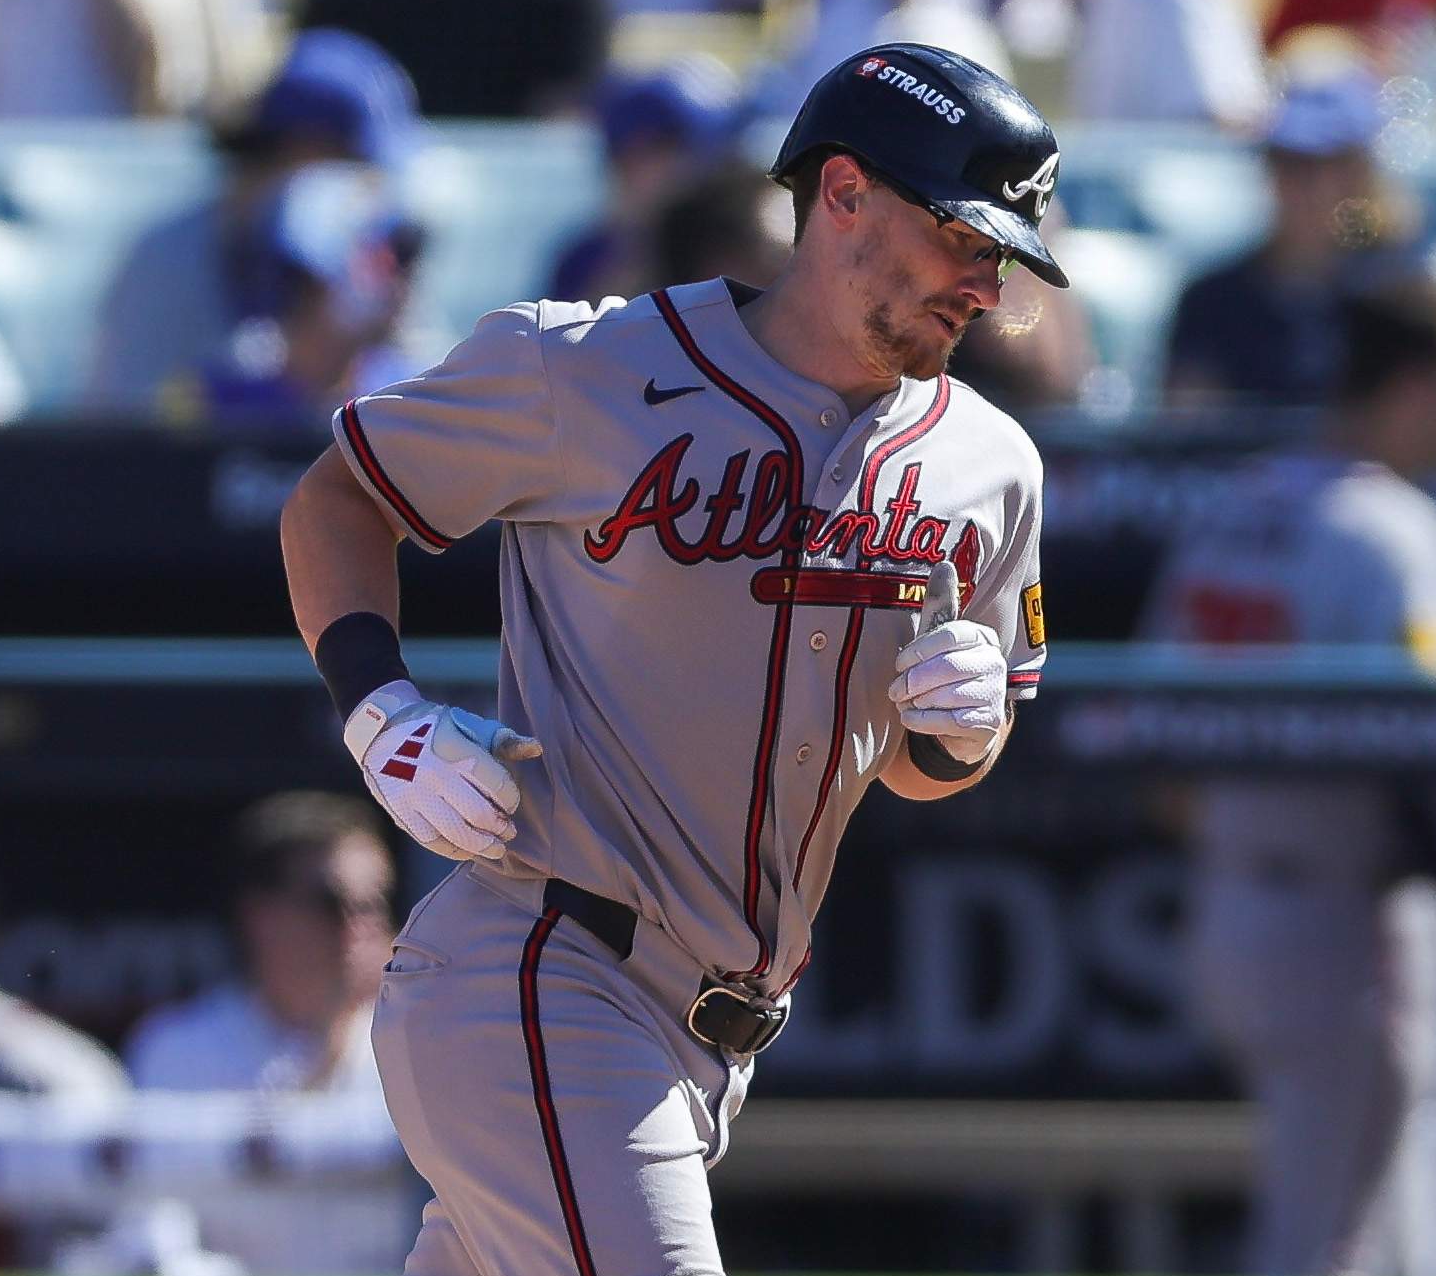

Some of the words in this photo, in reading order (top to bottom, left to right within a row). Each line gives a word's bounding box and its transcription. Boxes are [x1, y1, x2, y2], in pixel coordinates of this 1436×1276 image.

[877, 65, 966, 125] STRAUSS
[1002, 151, 1061, 219] A
[583, 432, 946, 566] Atlanta
